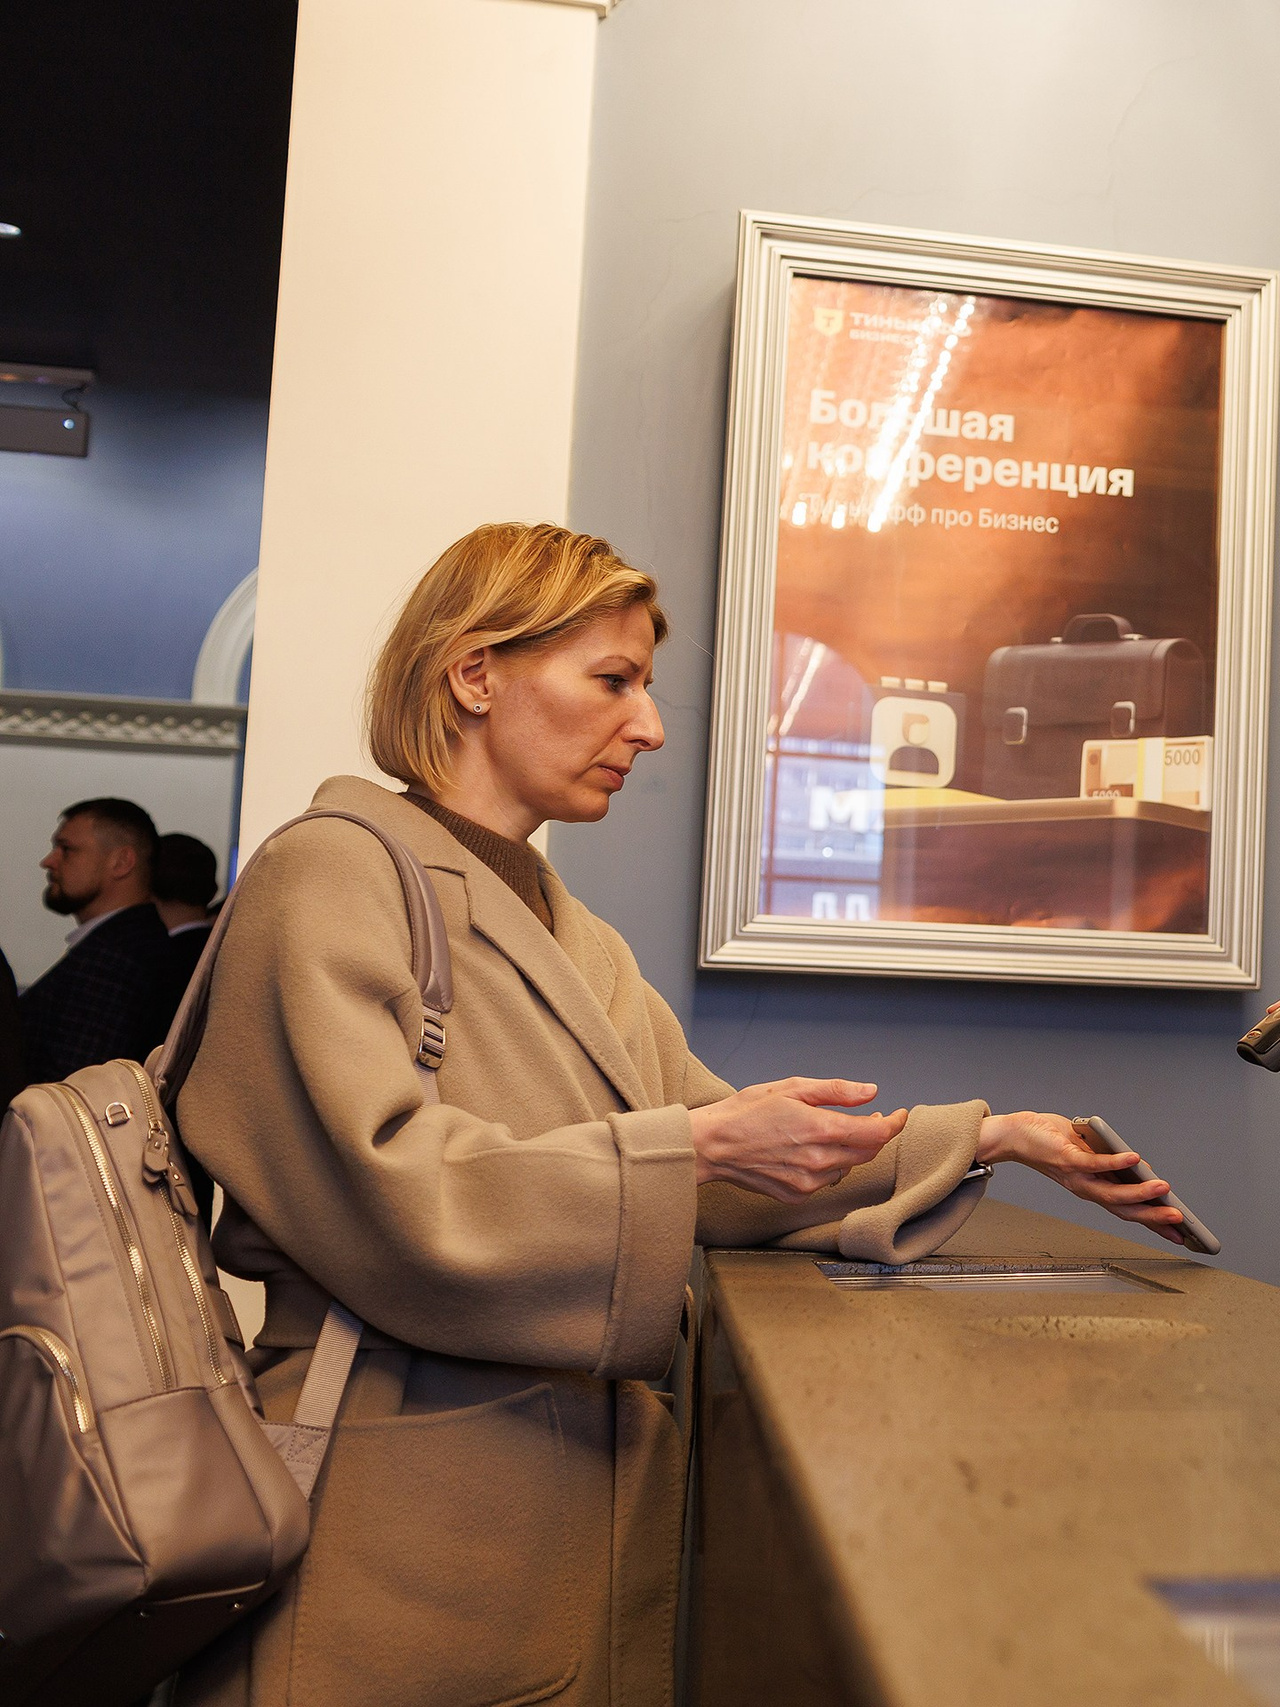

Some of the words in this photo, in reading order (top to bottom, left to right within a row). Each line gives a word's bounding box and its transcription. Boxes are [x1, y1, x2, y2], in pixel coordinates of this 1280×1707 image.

[850, 312, 973, 337] ТИНЬКФФ
[806, 441, 1136, 499] коференция
[930, 507, 974, 530] про
[977, 508, 1060, 535] Бизнес
[1164, 748, 1201, 766] 5000
